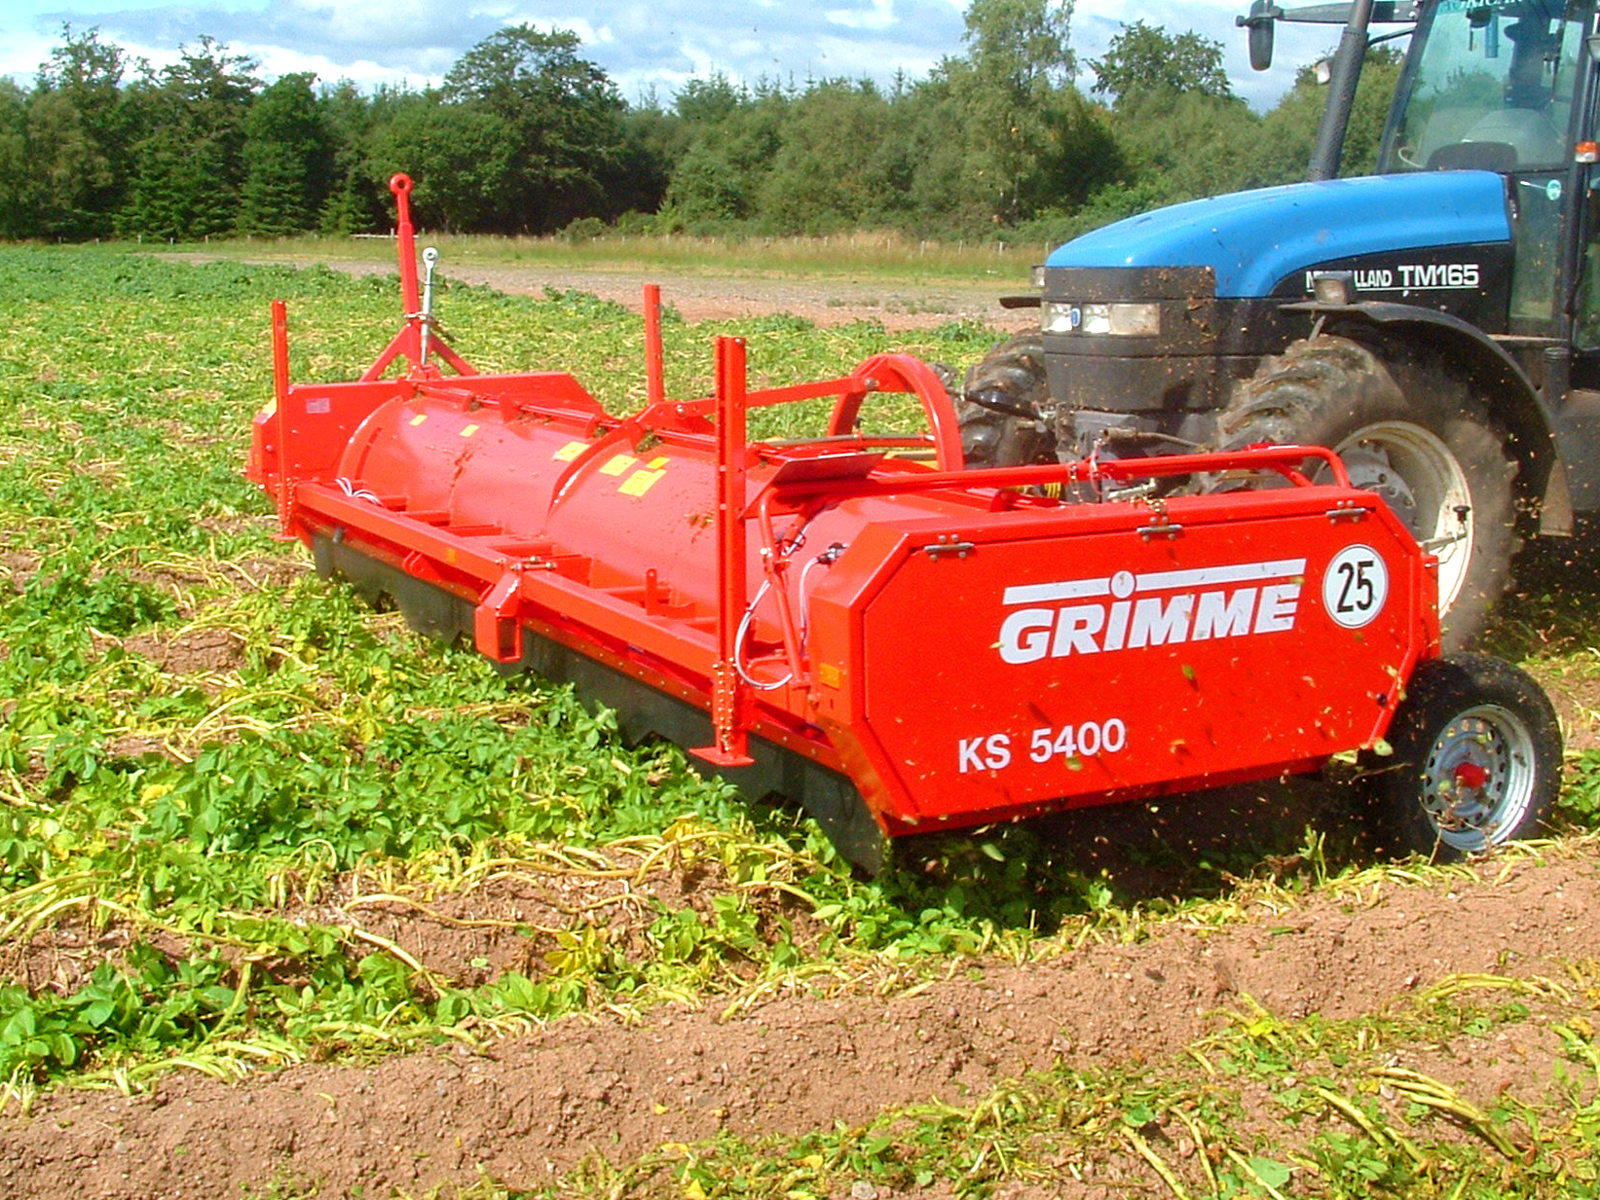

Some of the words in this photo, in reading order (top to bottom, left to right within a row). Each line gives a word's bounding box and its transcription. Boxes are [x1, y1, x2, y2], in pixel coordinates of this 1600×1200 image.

[1398, 264, 1479, 287] TM165
[1336, 560, 1375, 614] 25
[999, 580, 1301, 665] GRIMME
[958, 733, 1011, 774] KS
[1030, 717, 1126, 763] 5400
